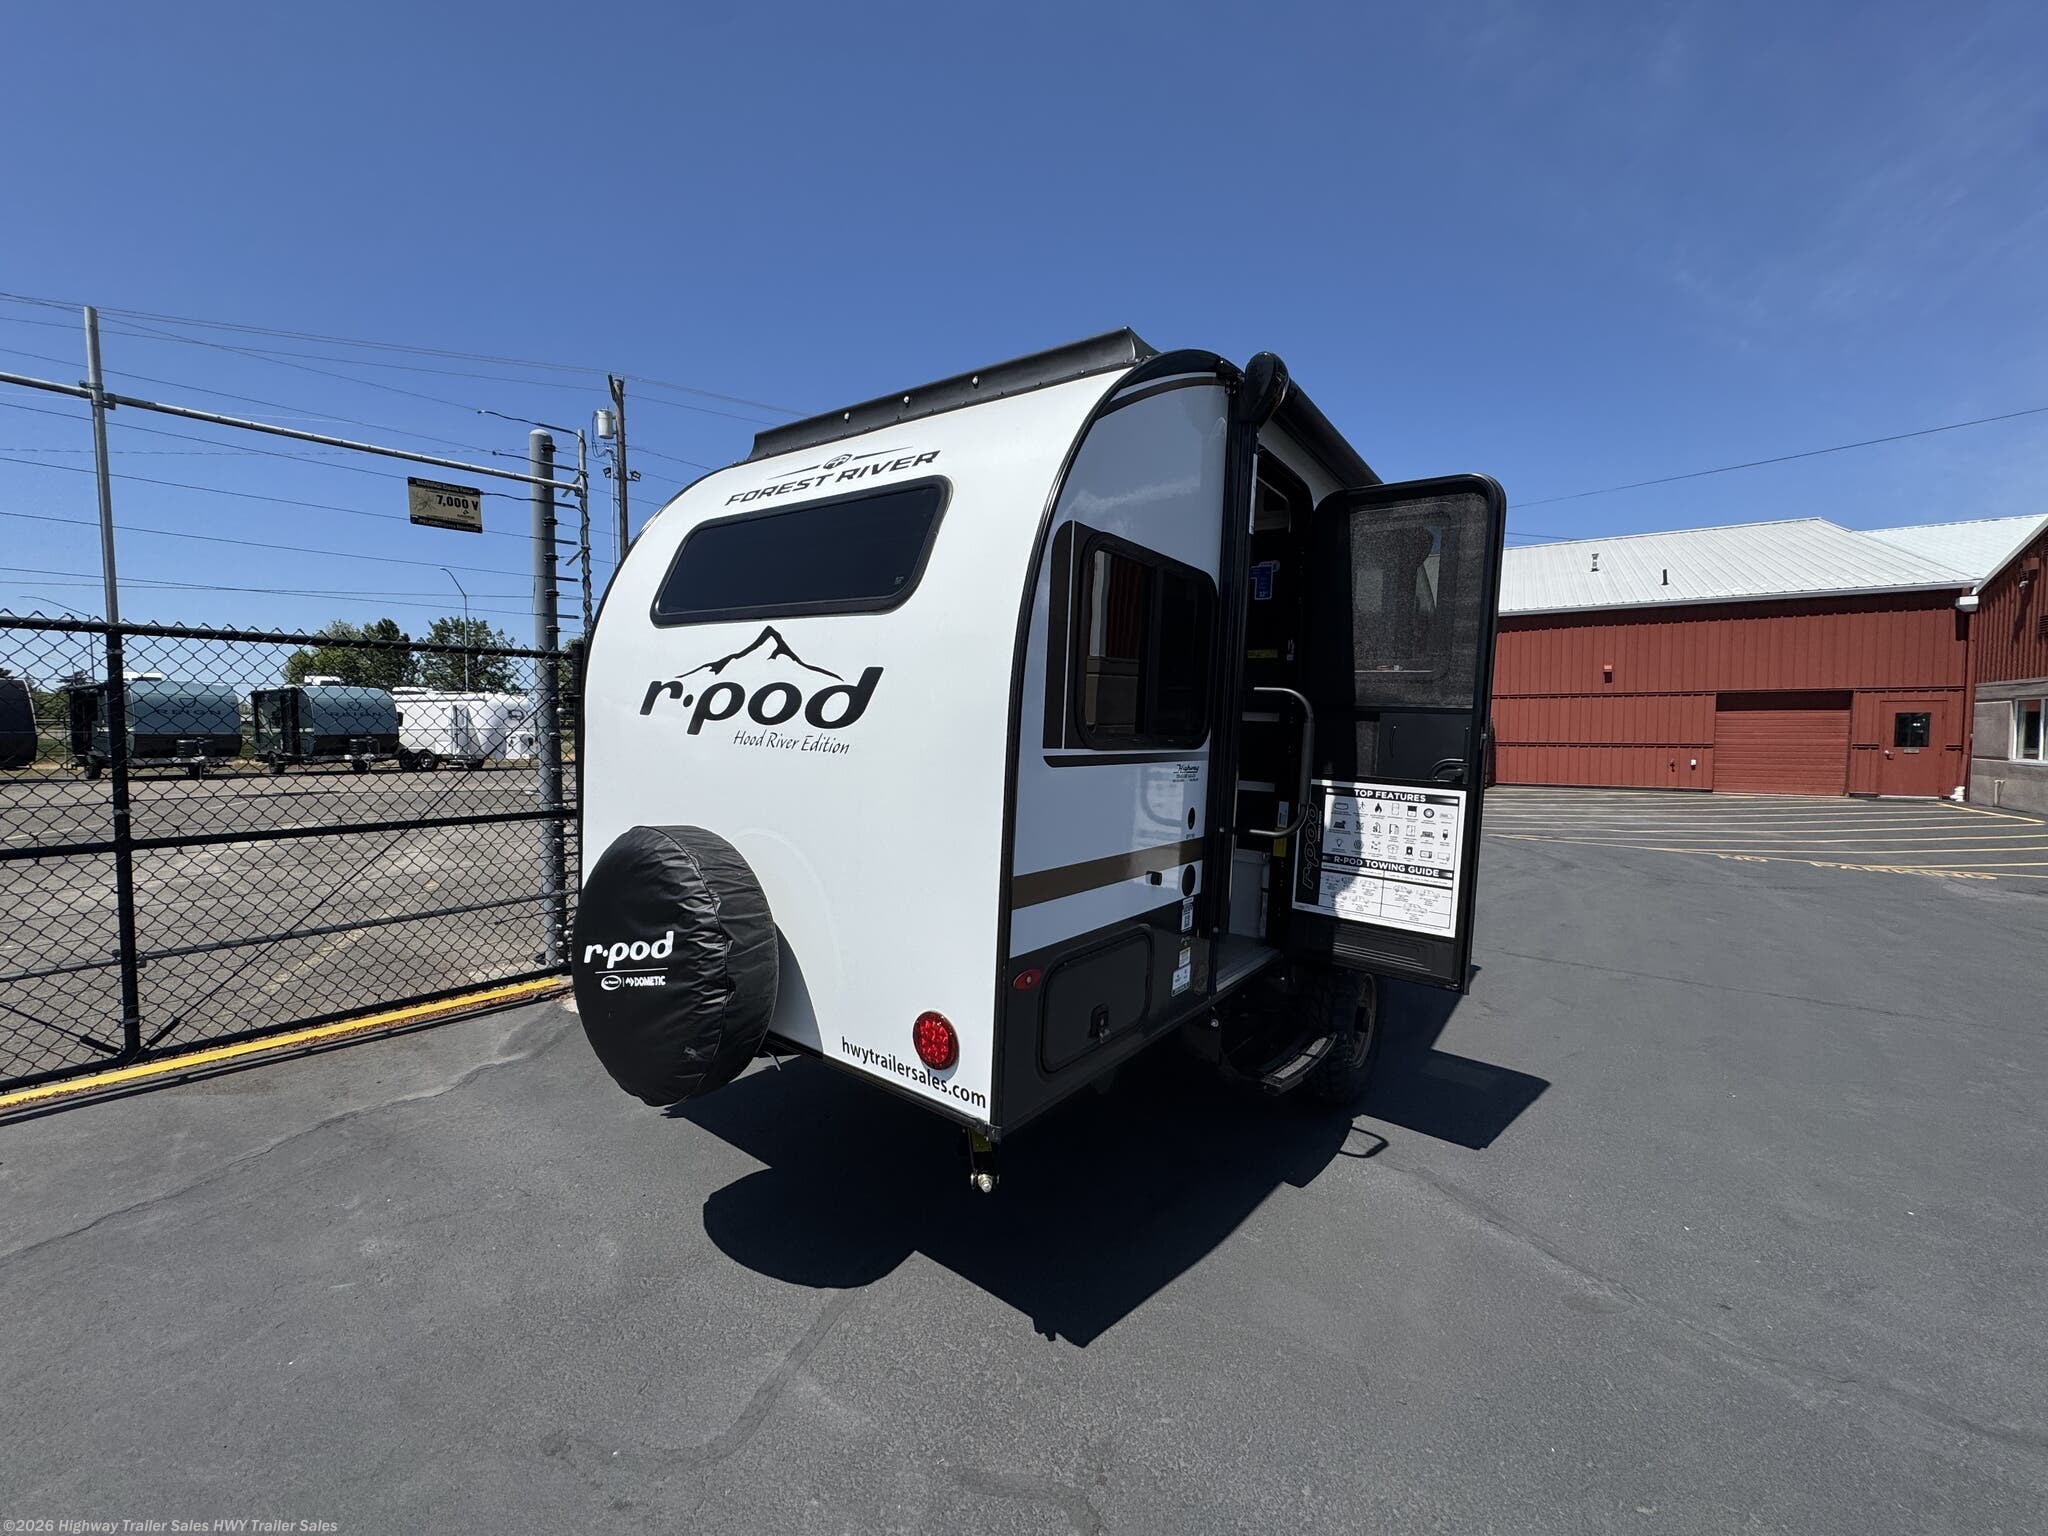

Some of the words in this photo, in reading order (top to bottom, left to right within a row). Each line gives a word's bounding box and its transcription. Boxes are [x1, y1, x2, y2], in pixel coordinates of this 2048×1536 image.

[725, 473, 833, 506] FOREST
[834, 450, 941, 483] RIVER
[436, 494, 469, 509] 7,000
[471, 500, 479, 511] V
[733, 729, 767, 747] Hood
[765, 732, 800, 750] River
[800, 733, 850, 755] Edition
[1354, 788, 1374, 798] TOP
[1375, 790, 1427, 803] FEATURES
[1333, 855, 1363, 866] R-POD
[1365, 859, 1406, 873] TOWING
[1407, 865, 1440, 878] GUIDE
[634, 975, 667, 987] DOMETIC
[841, 1036, 987, 1109] hwytrailersales.com
